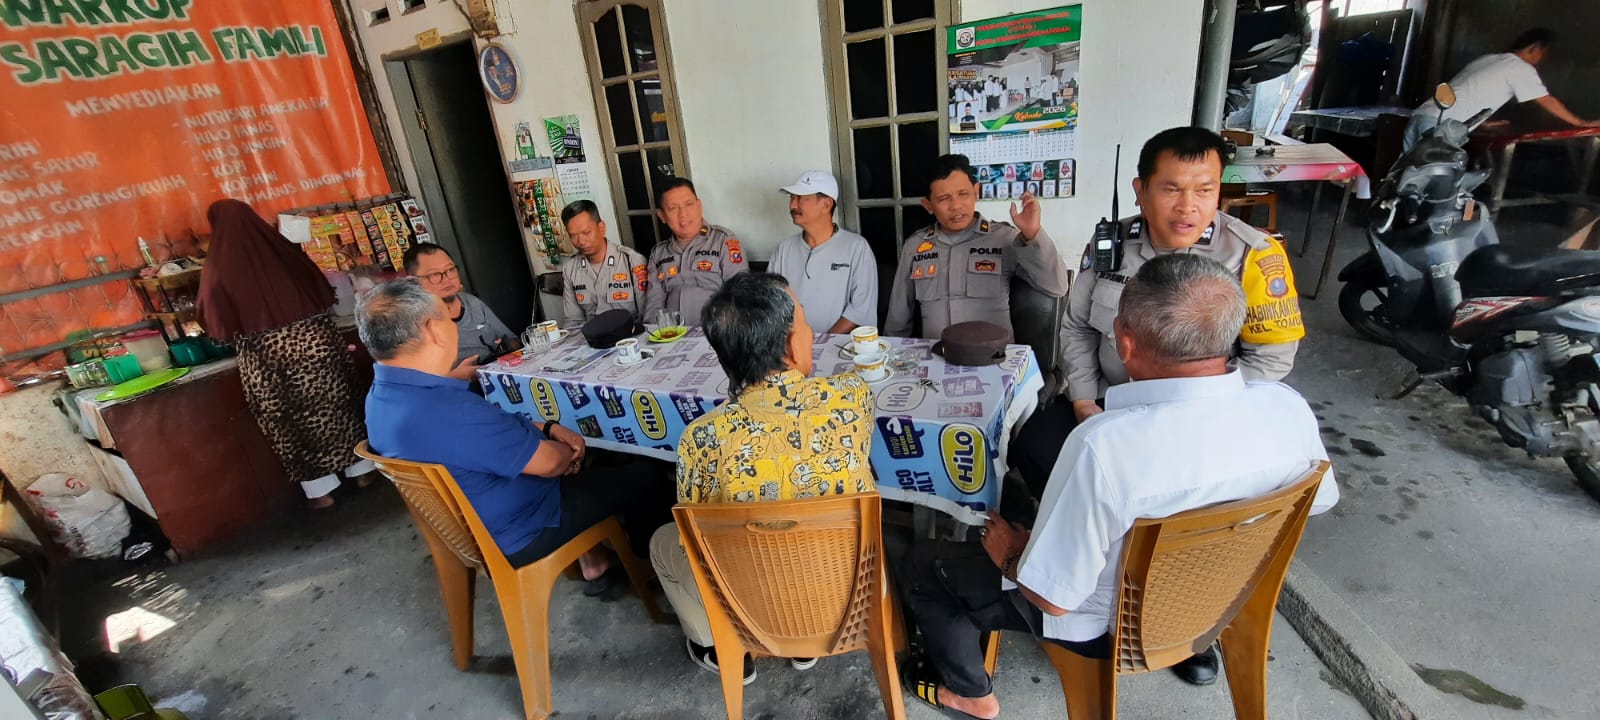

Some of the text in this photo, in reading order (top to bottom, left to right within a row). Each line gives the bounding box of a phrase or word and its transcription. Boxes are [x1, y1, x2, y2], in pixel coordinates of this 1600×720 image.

[0, 31, 213, 84] SARAGIH
[65, 83, 221, 117] MENYEDIAKAN
[32, 151, 100, 175] SAYUR
[211, 160, 246, 178] KOPI
[912, 252, 939, 262] AZHARI
[970, 247, 1002, 255] POLRI
[1248, 323, 1272, 335] KEL.
[623, 426, 639, 446] ALT
[913, 470, 936, 496] ALT
